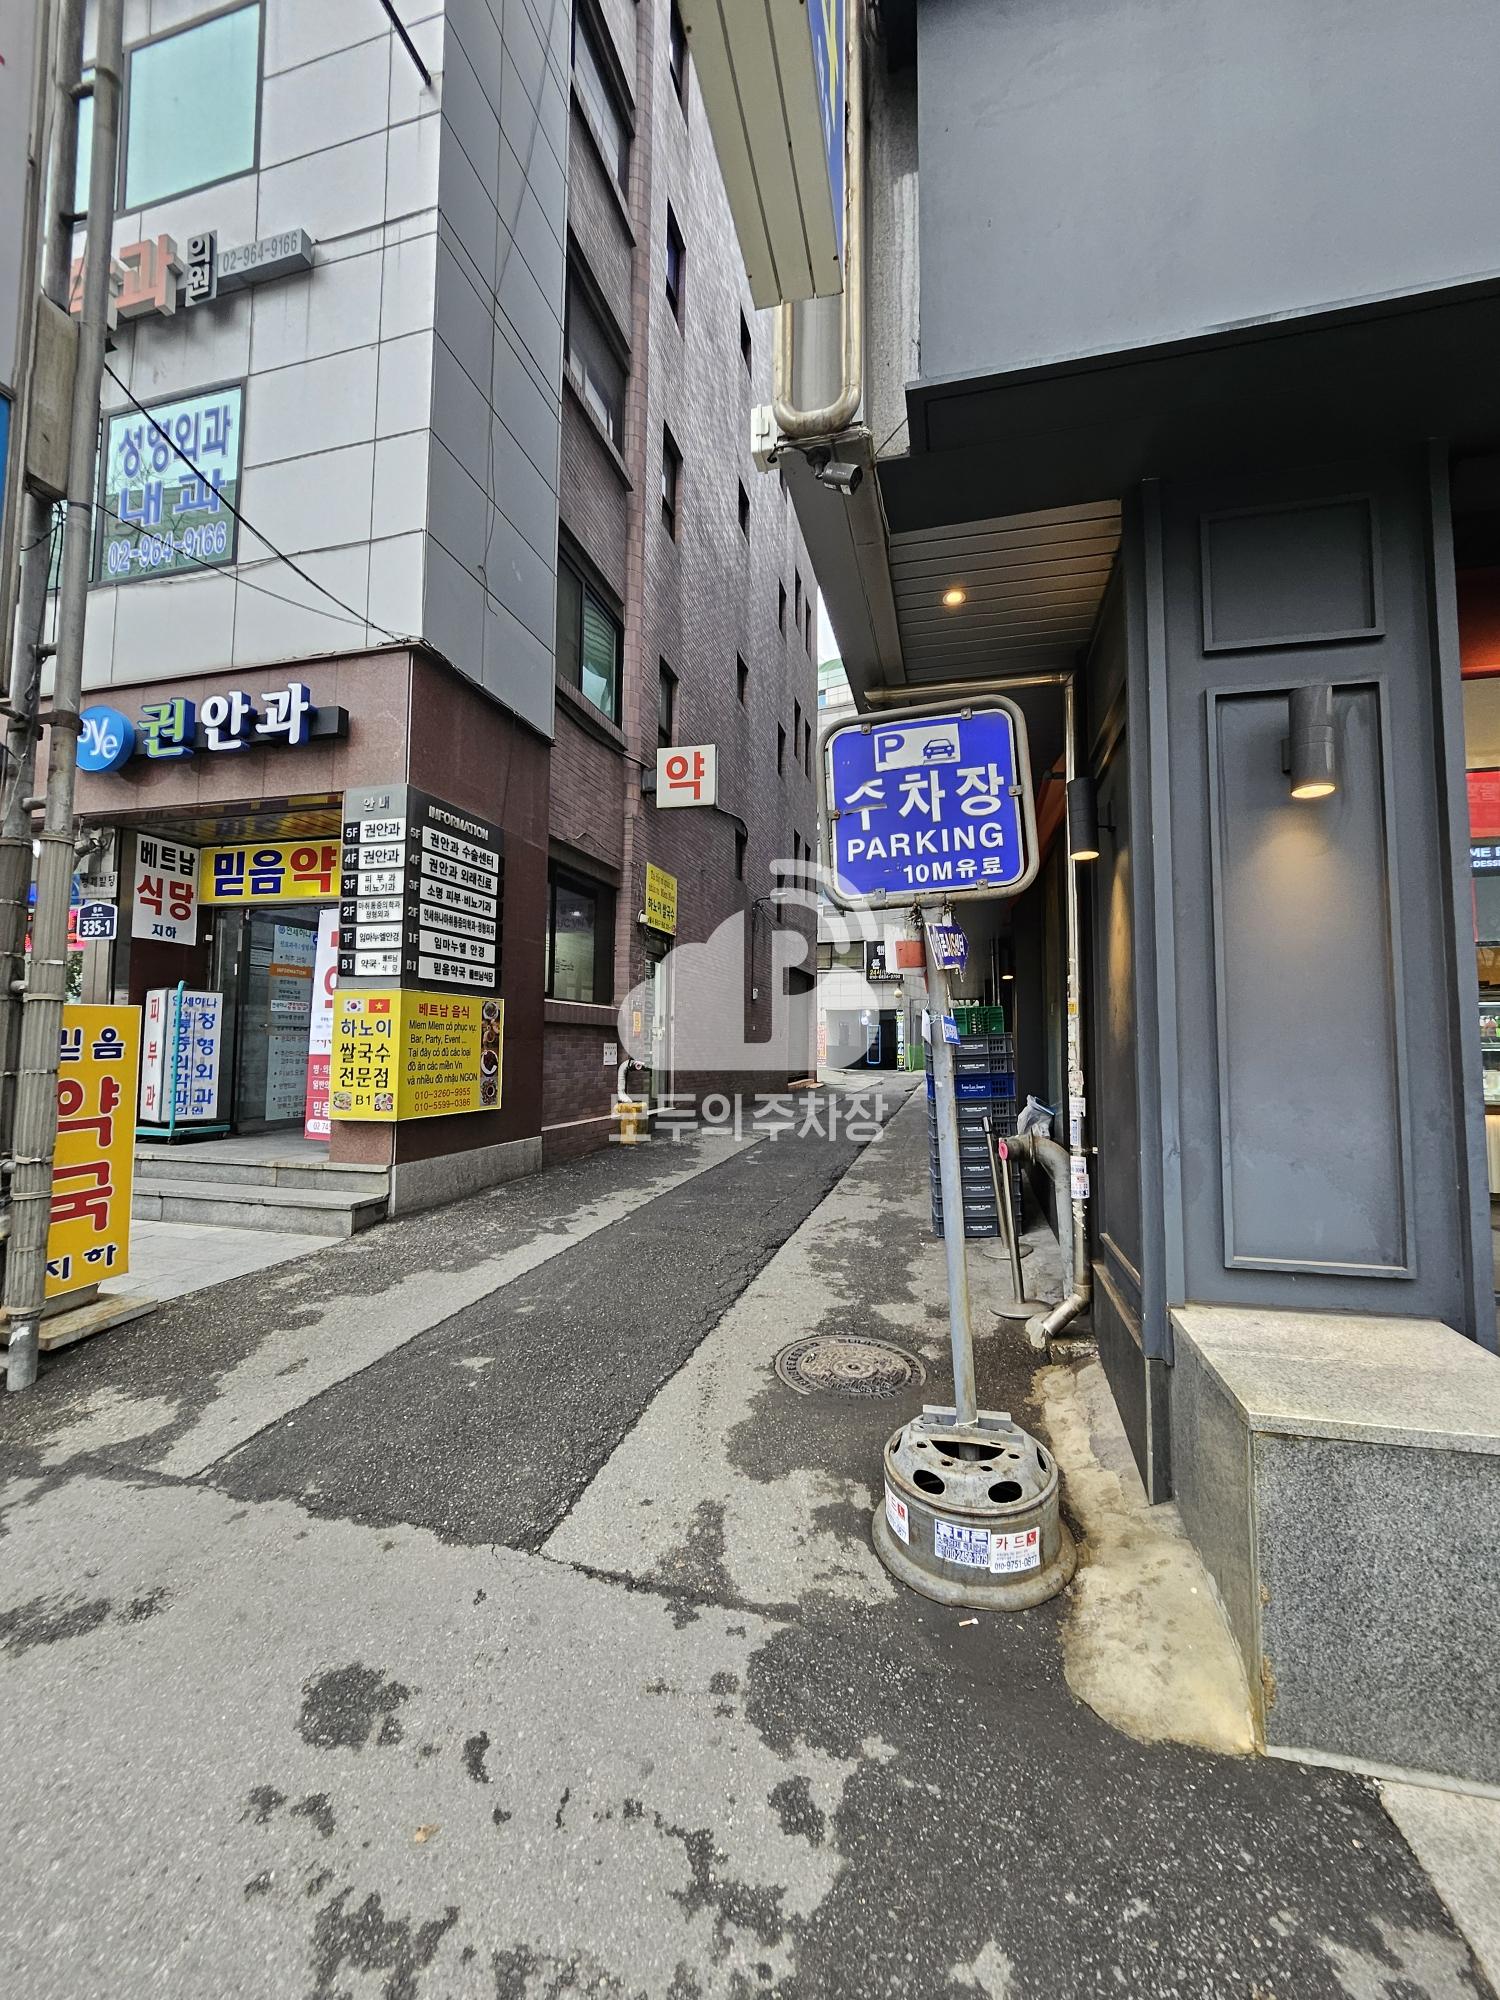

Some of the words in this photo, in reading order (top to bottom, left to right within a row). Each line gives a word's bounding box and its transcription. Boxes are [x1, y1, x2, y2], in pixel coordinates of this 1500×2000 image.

[222, 232, 298, 273] 02-964-9166
[187, 233, 212, 300] 의원
[107, 521, 227, 574] 02-964-9166
[138, 682, 309, 758] 권안과
[666, 751, 705, 801] 약
[363, 795, 390, 812] 안내
[345, 828, 358, 838] 5F
[364, 822, 400, 838] 권안과
[428, 805, 489, 841] INFORMATION
[410, 827, 421, 839] 5F
[430, 832, 459, 856] 권안과
[462, 845, 494, 869] 수술센터
[847, 822, 1004, 863] PARKING
[140, 840, 196, 877] 베트남
[344, 853, 357, 864] 4F
[363, 848, 400, 865] 권안과
[214, 845, 337, 897] 믿음약
[409, 854, 420, 865] 4F
[429, 858, 458, 880] 권안과
[461, 869, 492, 890] 외래진료
[343, 879, 356, 890] 3F
[364, 883, 395, 893] 비뇨기과
[408, 880, 420, 891] 3F
[427, 884, 443, 900] 소명
[136, 874, 194, 921] 식당
[342, 906, 355, 917] 2F
[407, 906, 419, 918] 2F
[81, 920, 111, 936] 335-1
[152, 923, 177, 939] 지하
[343, 932, 353, 942] 1F
[407, 932, 419, 944] 1F
[434, 936, 467, 955] 임마누엘
[470, 944, 485, 958] 안경
[341, 959, 353, 969] B1
[406, 960, 417, 971] B1
[433, 962, 466, 979] 믿음약국
[418, 1003, 449, 1018] 베트남
[451, 1005, 470, 1019] 음식
[341, 1018, 392, 1039] 하노이
[426, 1034, 443, 1046] Party,
[445, 1034, 460, 1044] Event
[193, 1012, 216, 1105] 정형외과
[339, 1043, 391, 1064] 쌀국수
[339, 1067, 389, 1089] 전문점
[459, 1072, 478, 1082] NGON
[355, 1094, 371, 1106] B1
